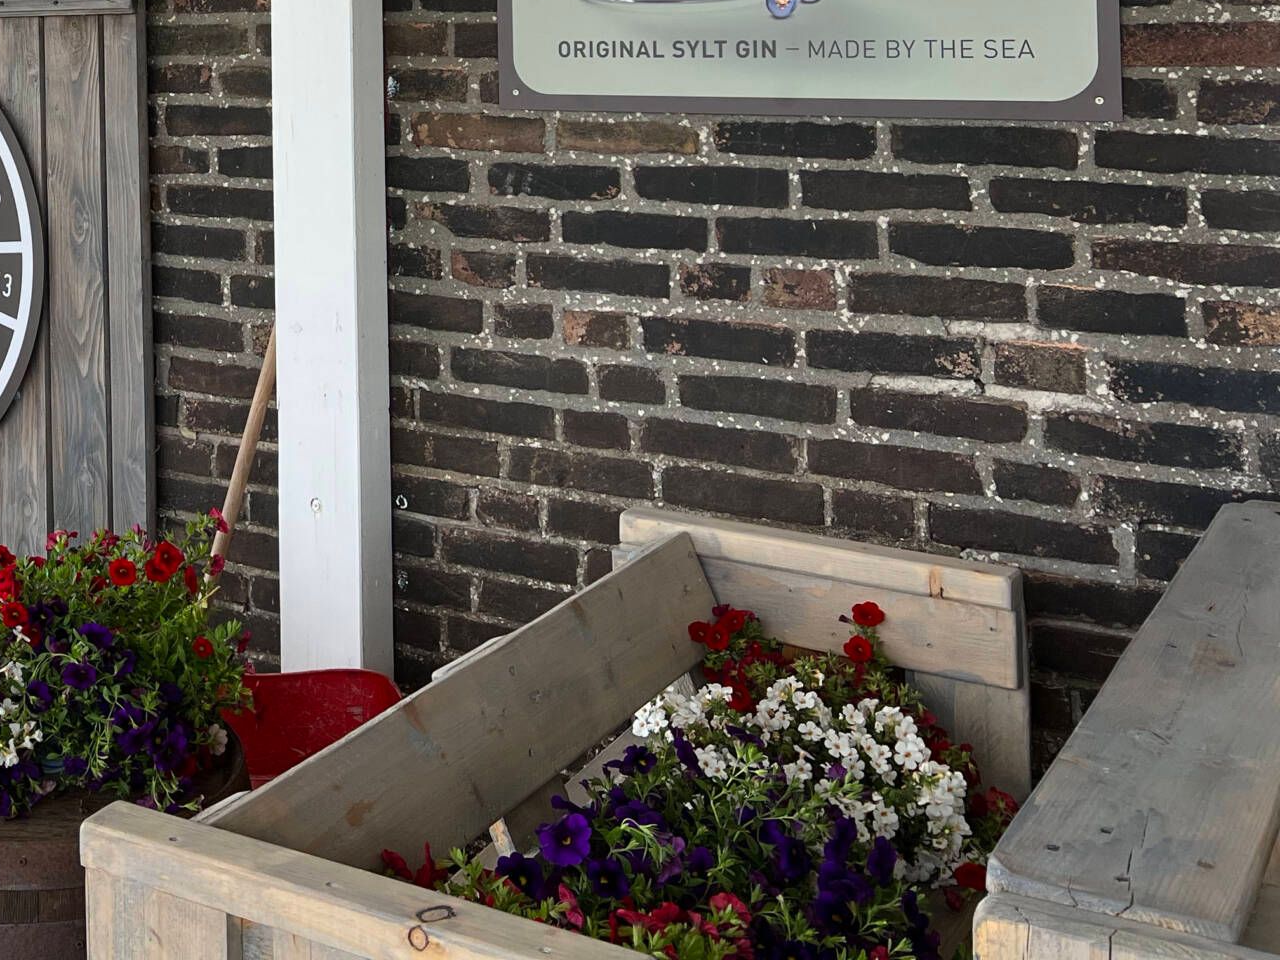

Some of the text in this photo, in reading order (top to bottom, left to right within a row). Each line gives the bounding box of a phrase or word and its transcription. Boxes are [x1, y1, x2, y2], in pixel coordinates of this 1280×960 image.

[557, 40, 665, 60] ORIGINAL
[672, 40, 727, 60] SYLT
[734, 40, 778, 59] GIN
[807, 40, 877, 60] MADE
[885, 40, 916, 59] BY
[924, 40, 975, 59] THE
[983, 40, 1035, 60] SEA
